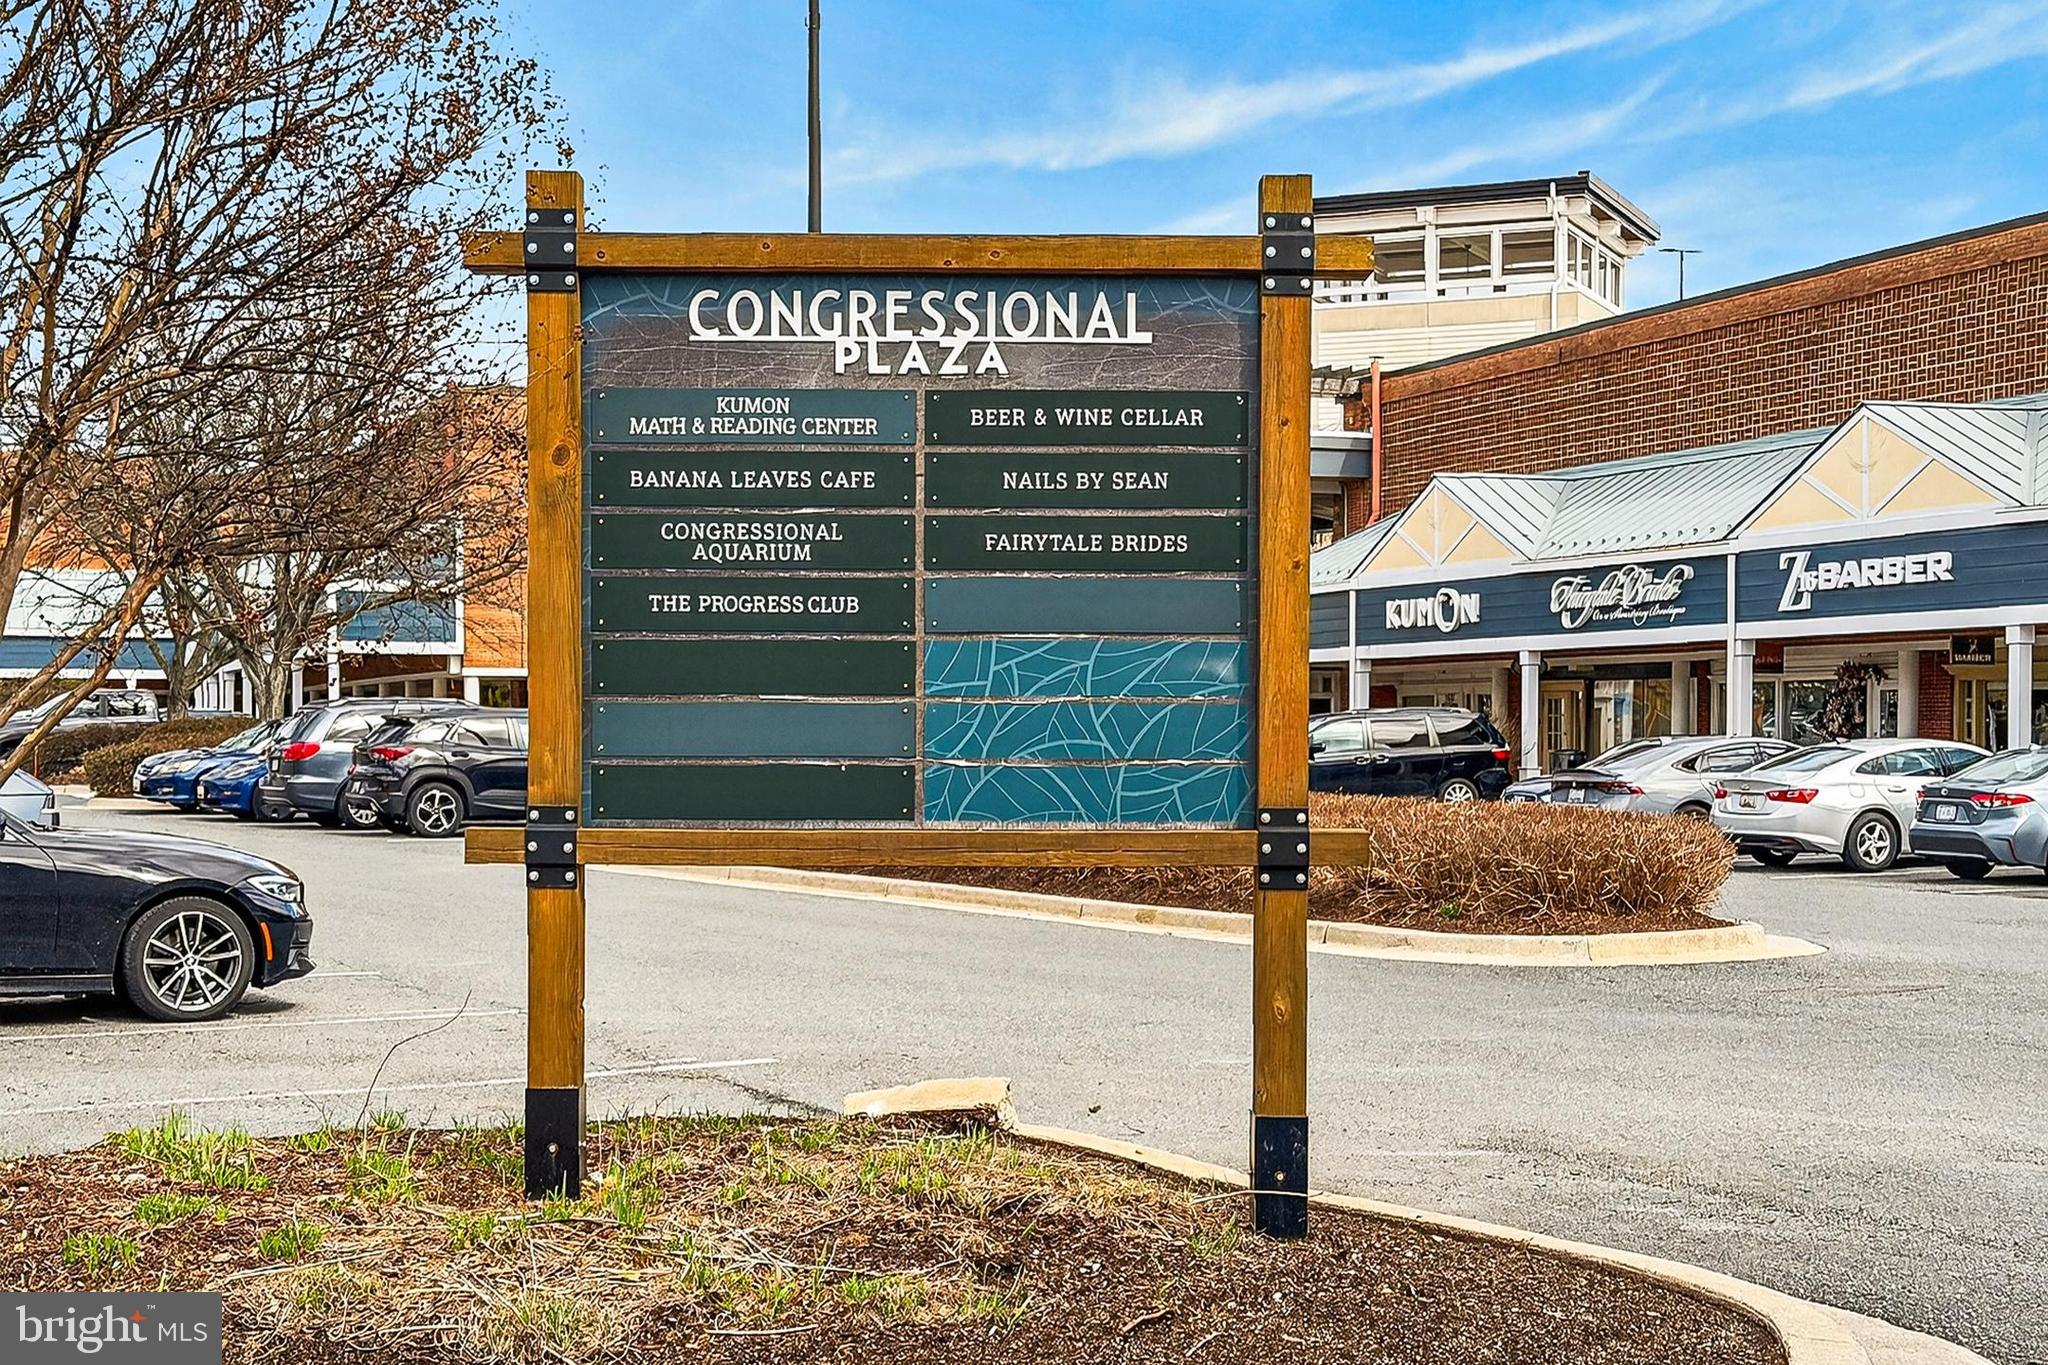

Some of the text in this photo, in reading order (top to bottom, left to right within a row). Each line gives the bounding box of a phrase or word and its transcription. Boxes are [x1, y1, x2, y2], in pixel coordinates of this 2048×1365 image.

[689, 290, 1153, 344] CONGRESSIONAL
[834, 341, 1010, 376] PLAZA
[716, 397, 791, 415] KUMON
[629, 417, 879, 436] MATH & READING CENTER
[970, 408, 1204, 427] BEER & WINE CELLAR
[630, 470, 875, 489] BANANA LEAVES CAFE
[1002, 472, 1169, 490] NAILS BY SEAN
[660, 522, 843, 541] CONGRESSIONAL
[984, 533, 1188, 552] FAIRYTALE BRIDES
[691, 543, 812, 564] AQUARIUM
[1818, 551, 1955, 591] BARBER
[648, 594, 860, 614] THE PROGRESS CLUB
[1386, 587, 1480, 633] KUMON
